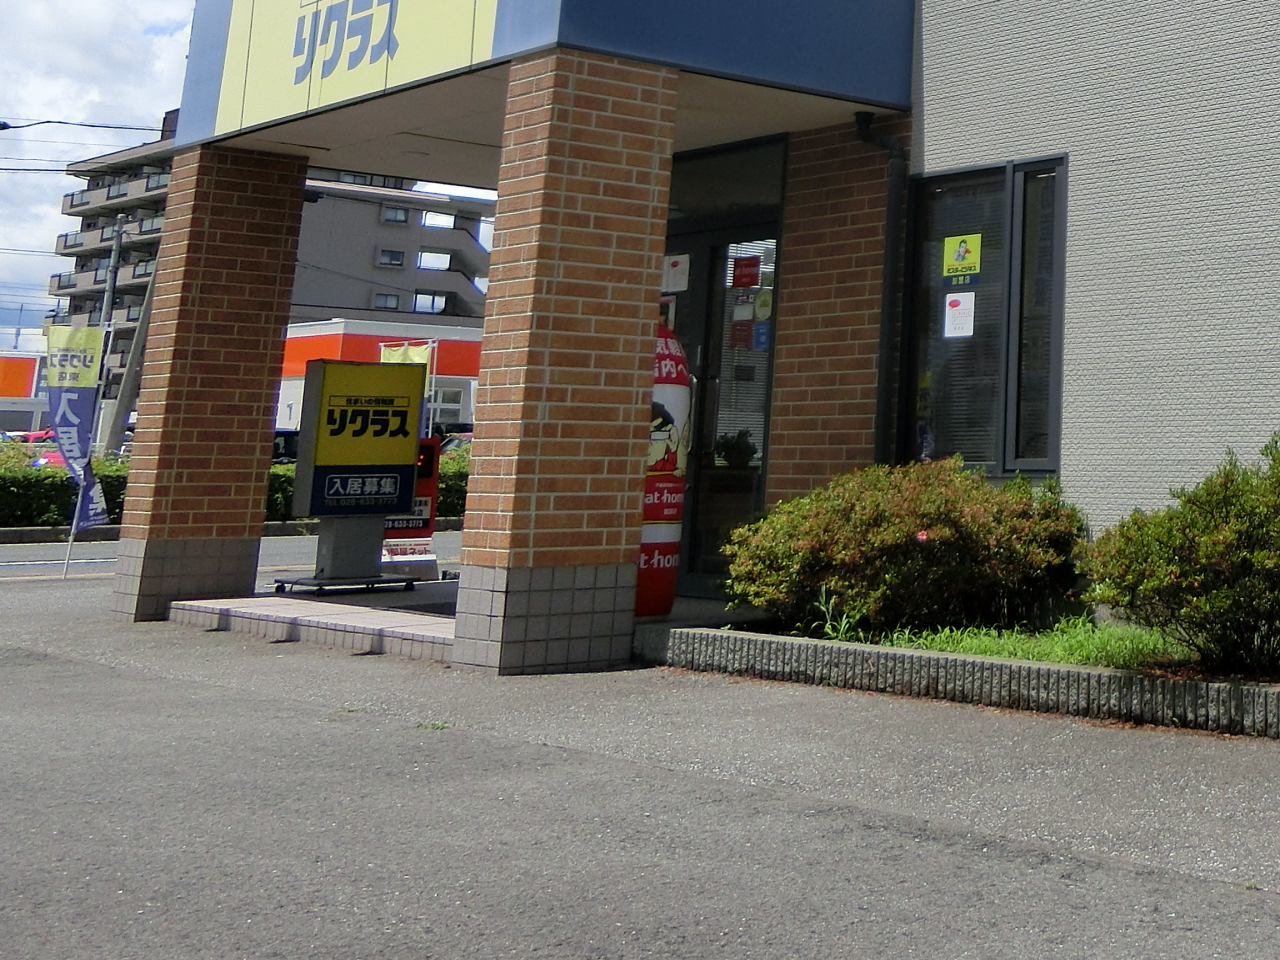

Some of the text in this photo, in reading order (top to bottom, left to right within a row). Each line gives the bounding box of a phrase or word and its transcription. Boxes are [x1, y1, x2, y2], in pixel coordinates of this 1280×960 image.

[326, 408, 411, 438] リクラス
[328, 477, 396, 495] 入居募集
